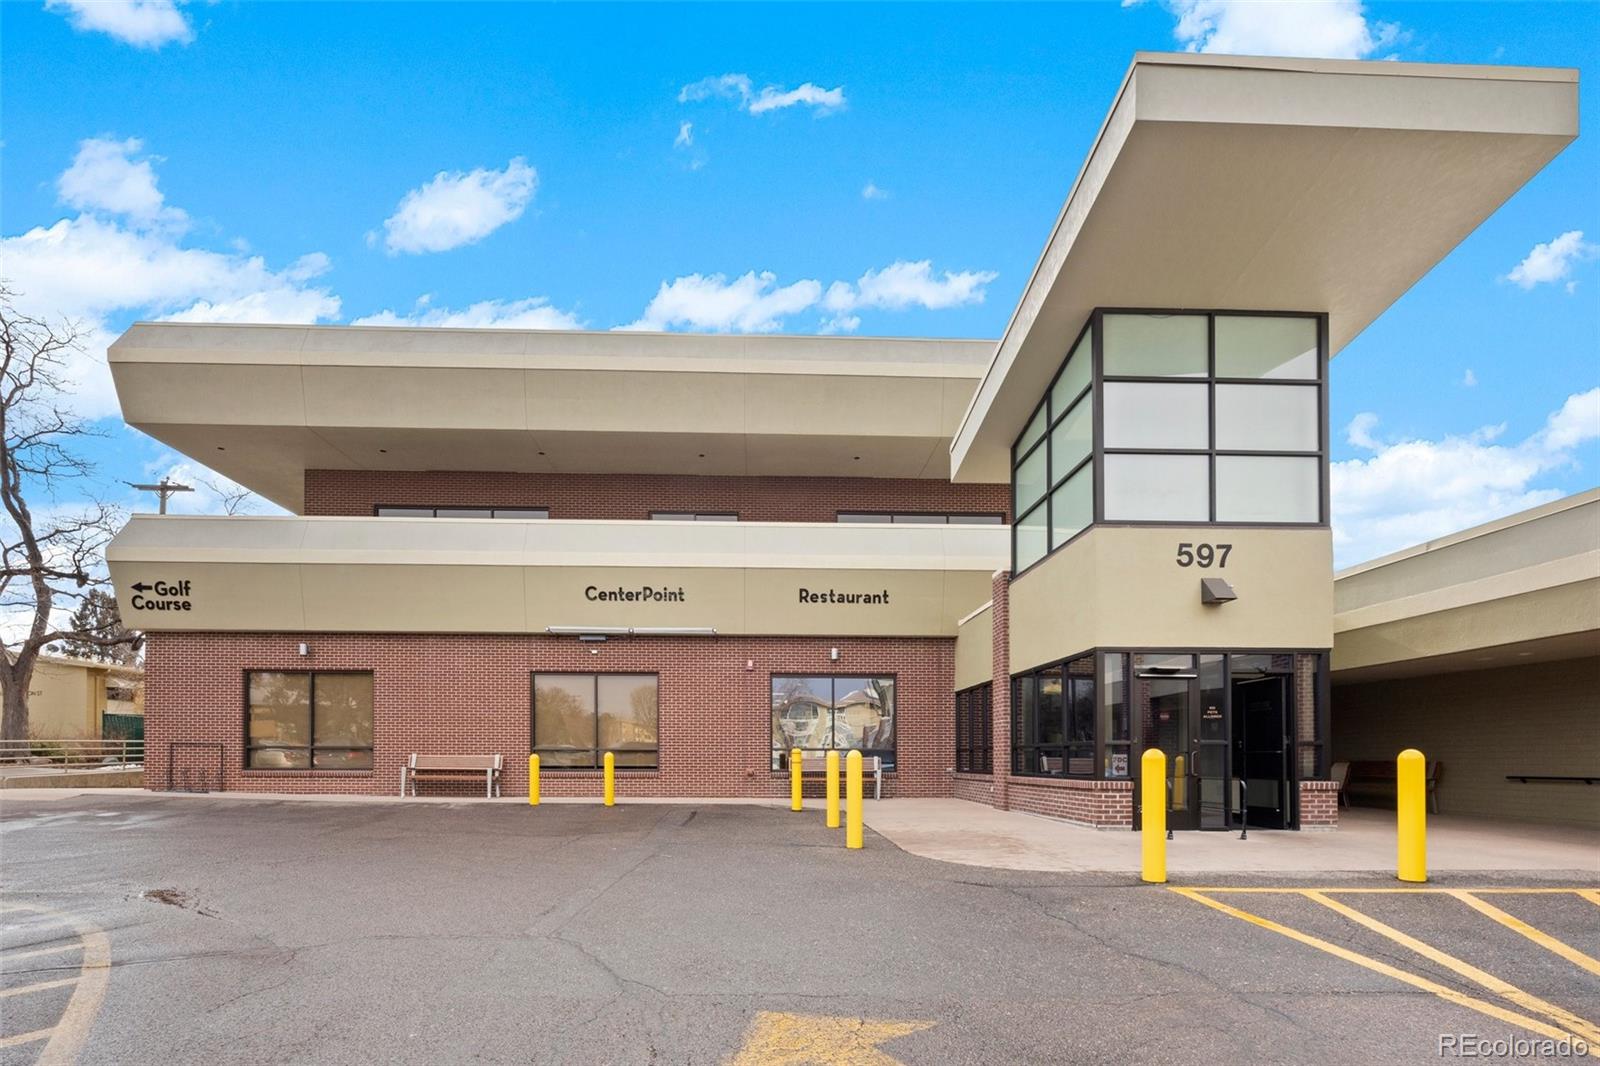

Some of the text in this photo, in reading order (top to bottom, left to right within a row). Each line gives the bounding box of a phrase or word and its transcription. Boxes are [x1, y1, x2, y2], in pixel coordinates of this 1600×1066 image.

[1176, 543, 1232, 568] 597
[154, 580, 191, 596] Golf
[584, 585, 685, 602] CenterPoint
[799, 588, 889, 604] Restaurant
[131, 595, 191, 611] Course
